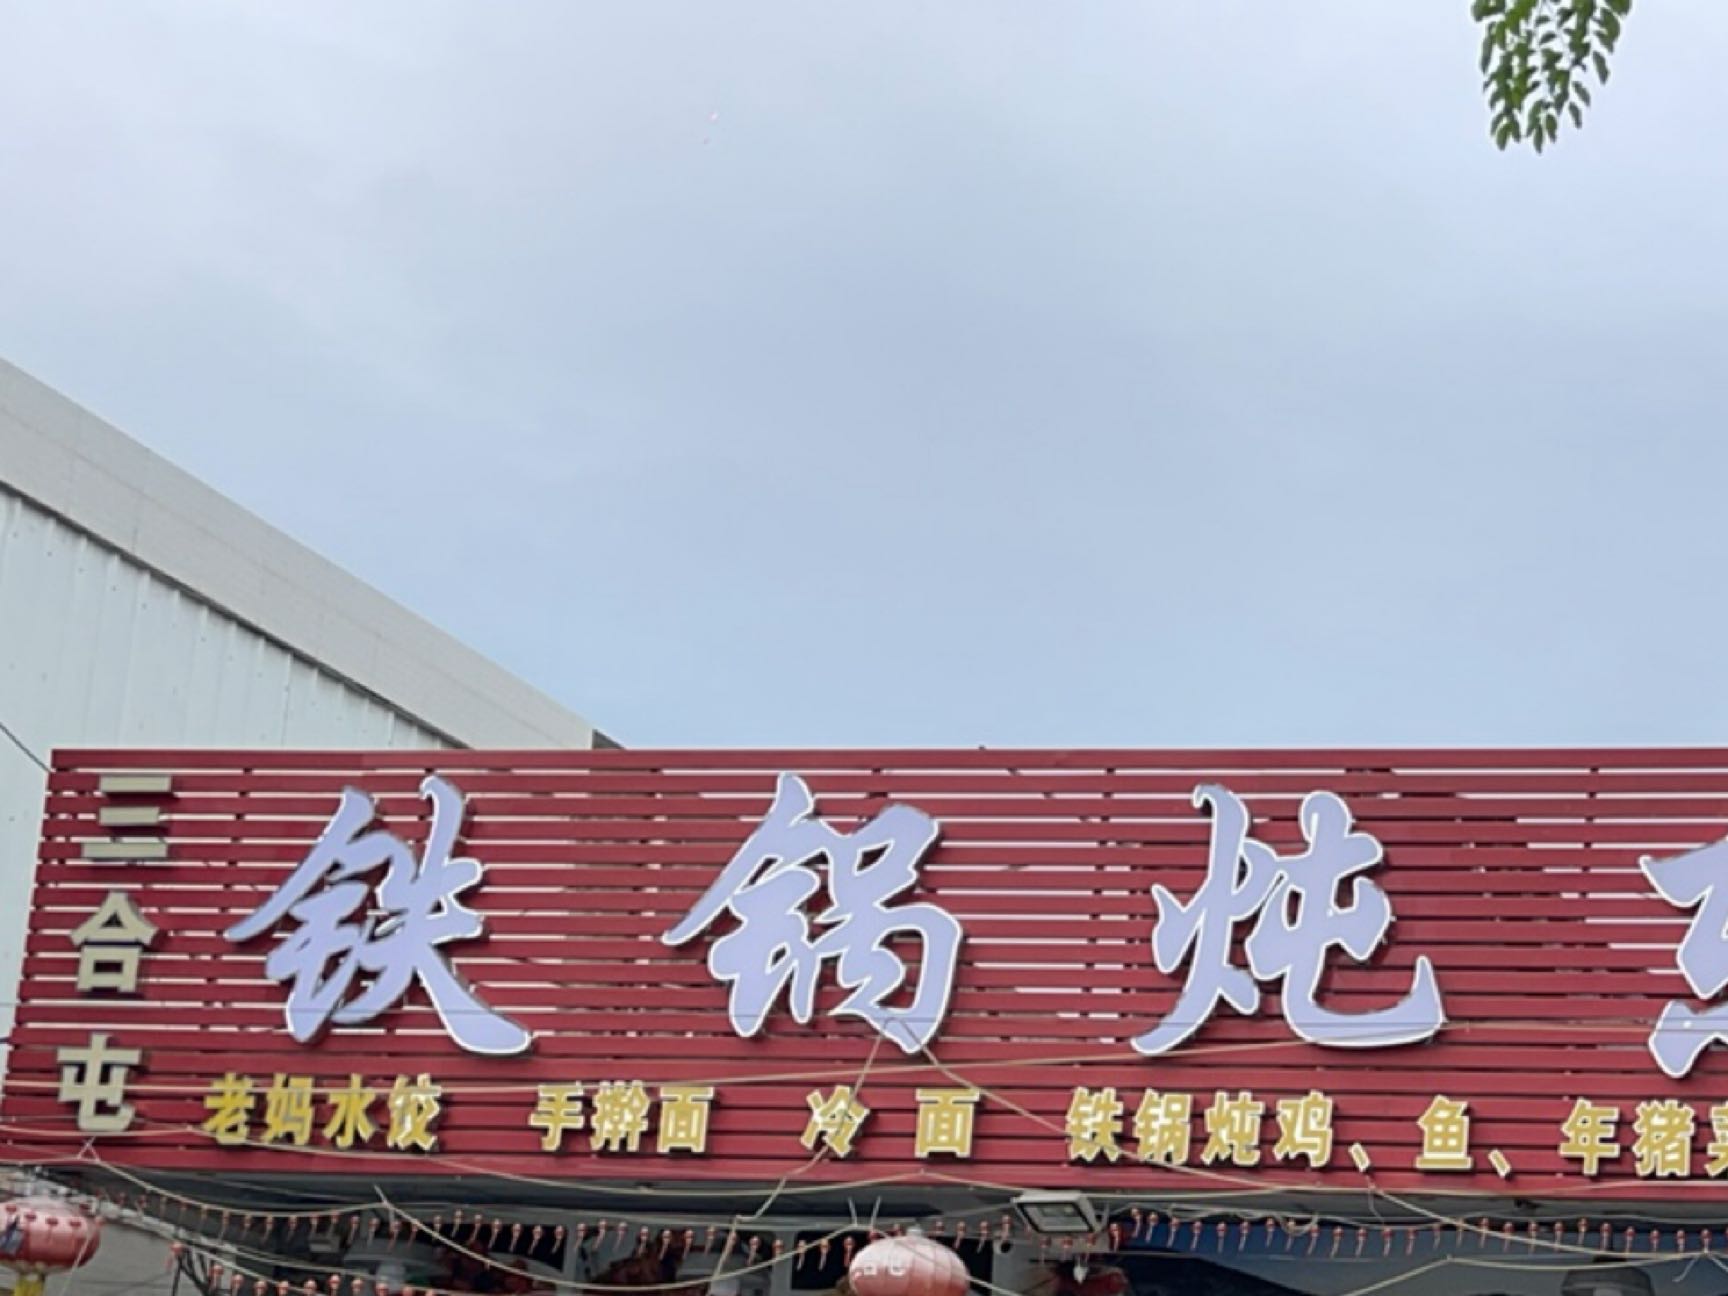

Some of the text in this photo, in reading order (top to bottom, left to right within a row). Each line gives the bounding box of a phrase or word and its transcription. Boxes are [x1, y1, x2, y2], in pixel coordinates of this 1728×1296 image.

[57, 773, 172, 1132] 三合屯
[203, 1072, 443, 1151] 老妈水饺
[530, 1080, 715, 1153] 手擀面
